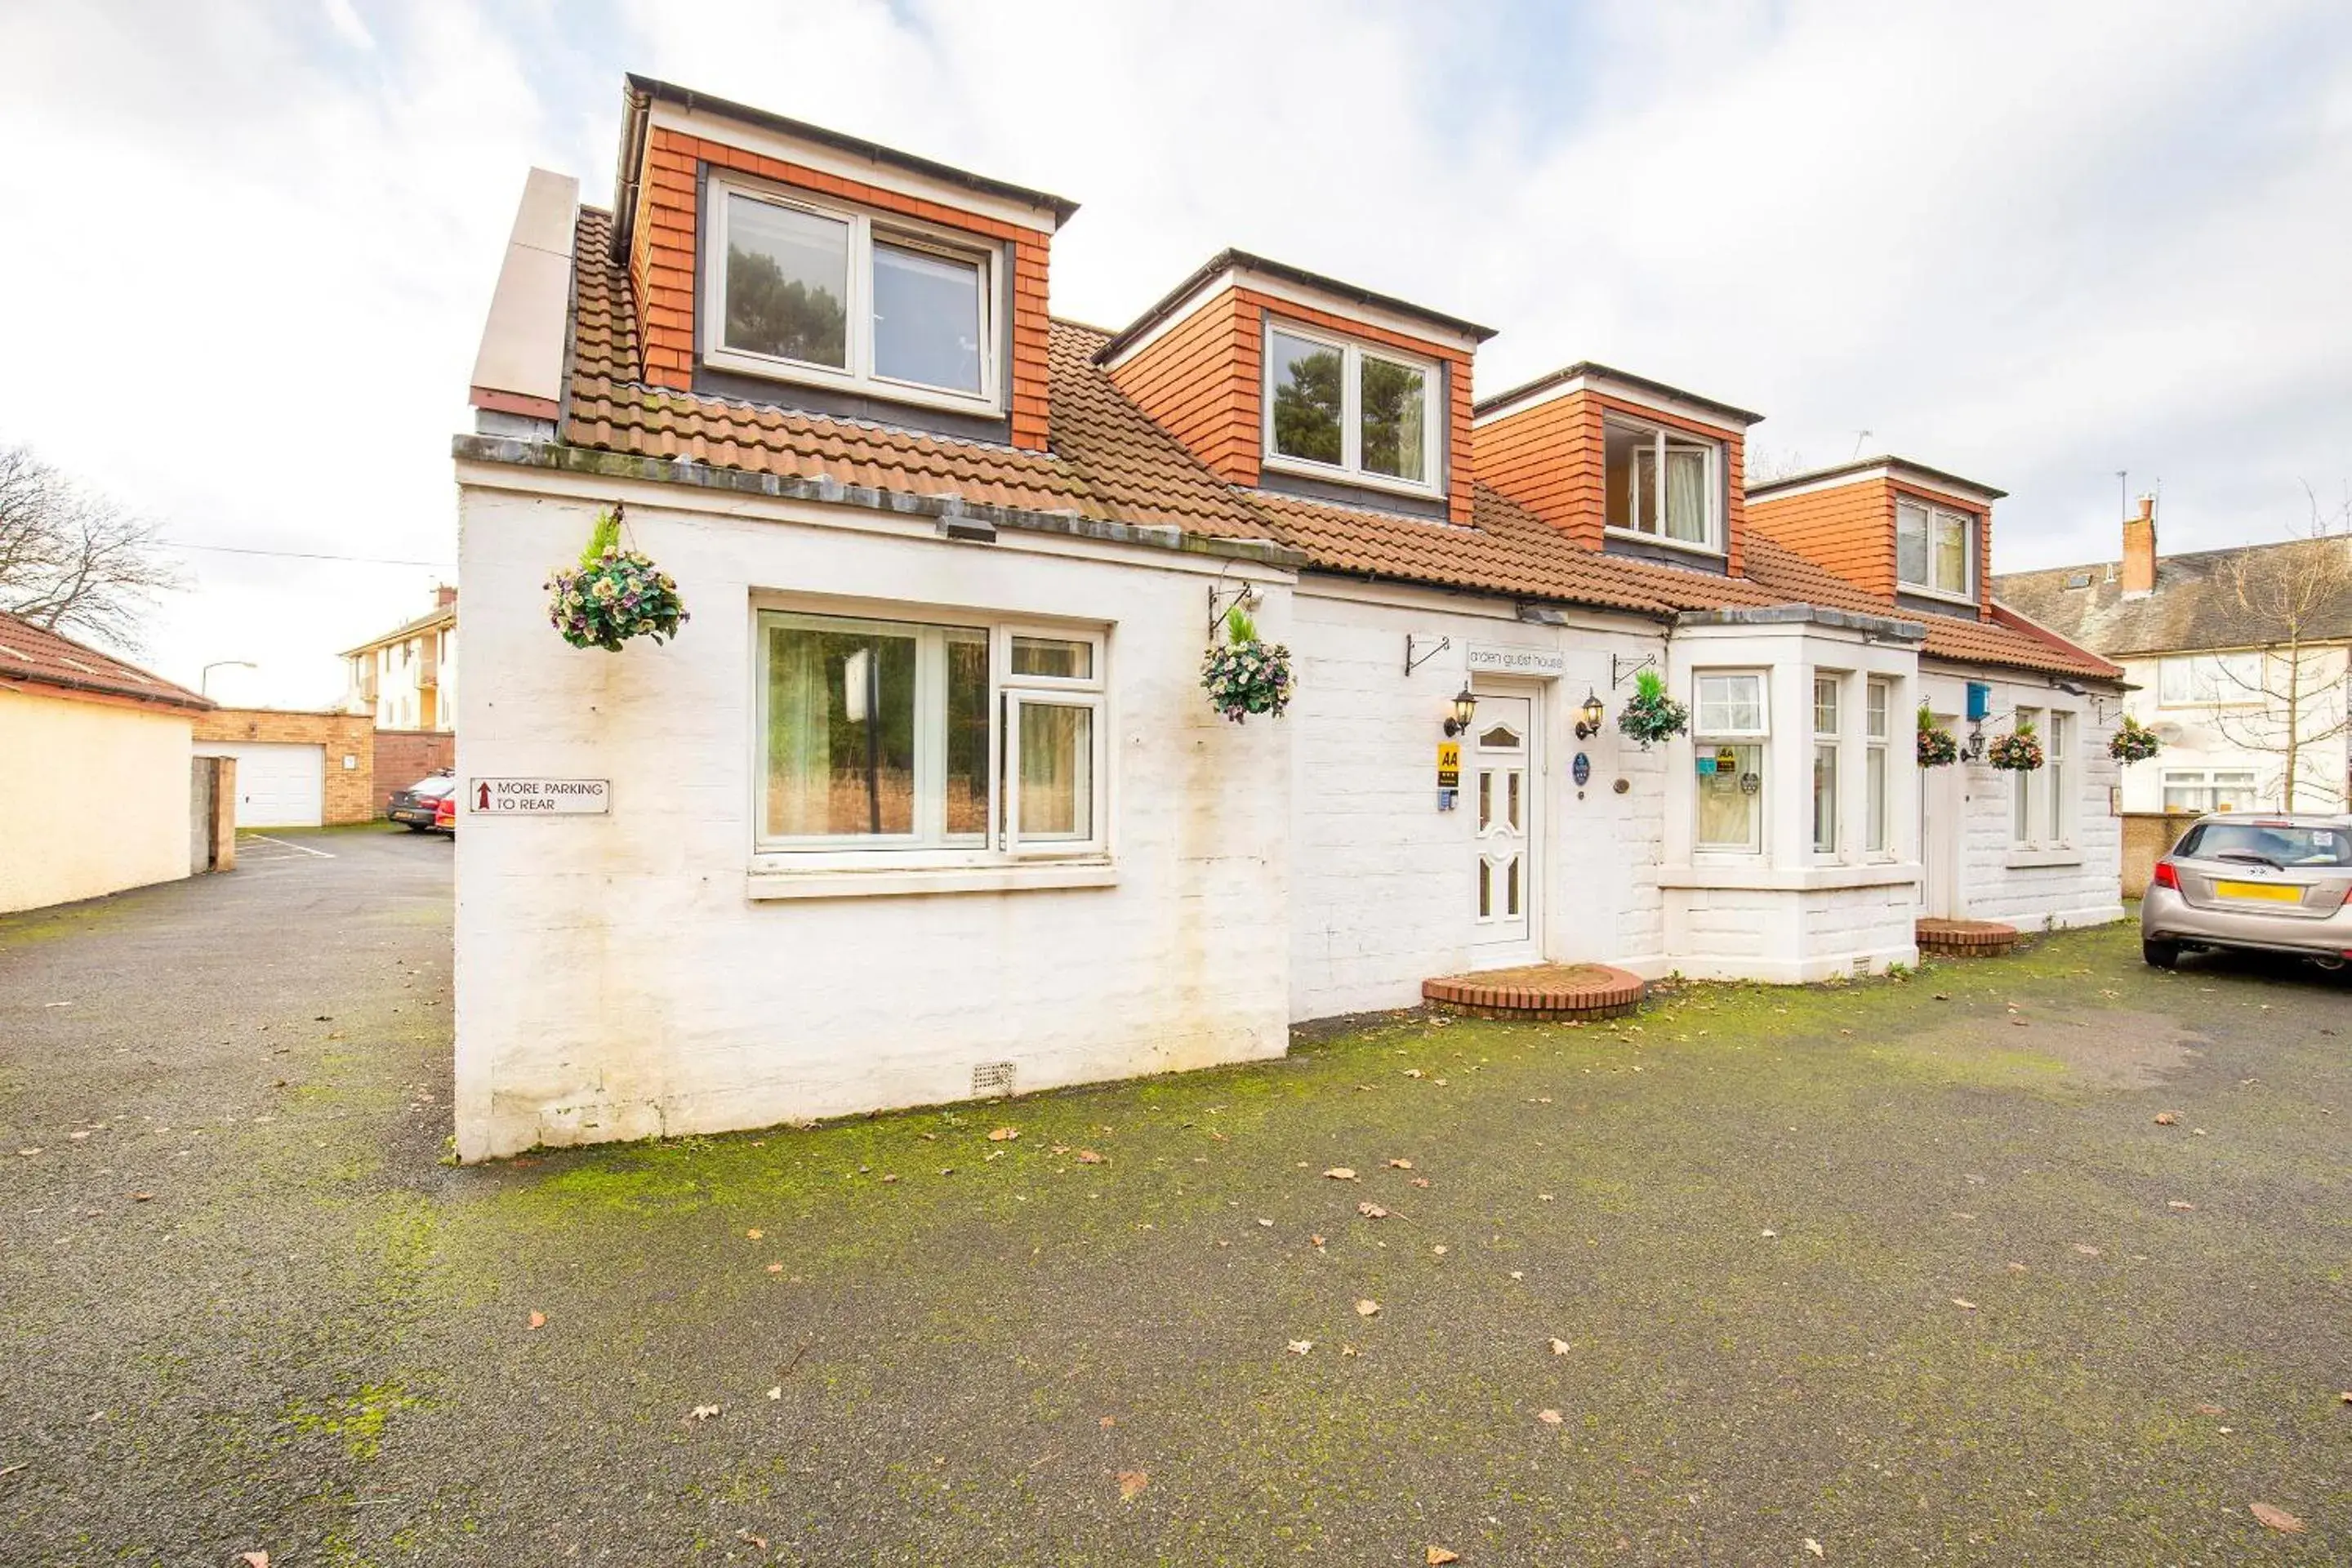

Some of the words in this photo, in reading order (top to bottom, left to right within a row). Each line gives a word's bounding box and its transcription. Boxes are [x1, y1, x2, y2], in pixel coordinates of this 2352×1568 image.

[1503, 653, 1530, 666] guest
[1442, 751, 1458, 766] AA
[498, 782, 539, 794] MORE
[545, 783, 603, 795] PARKING
[498, 798, 515, 809] TO
[520, 799, 555, 809] REAR
